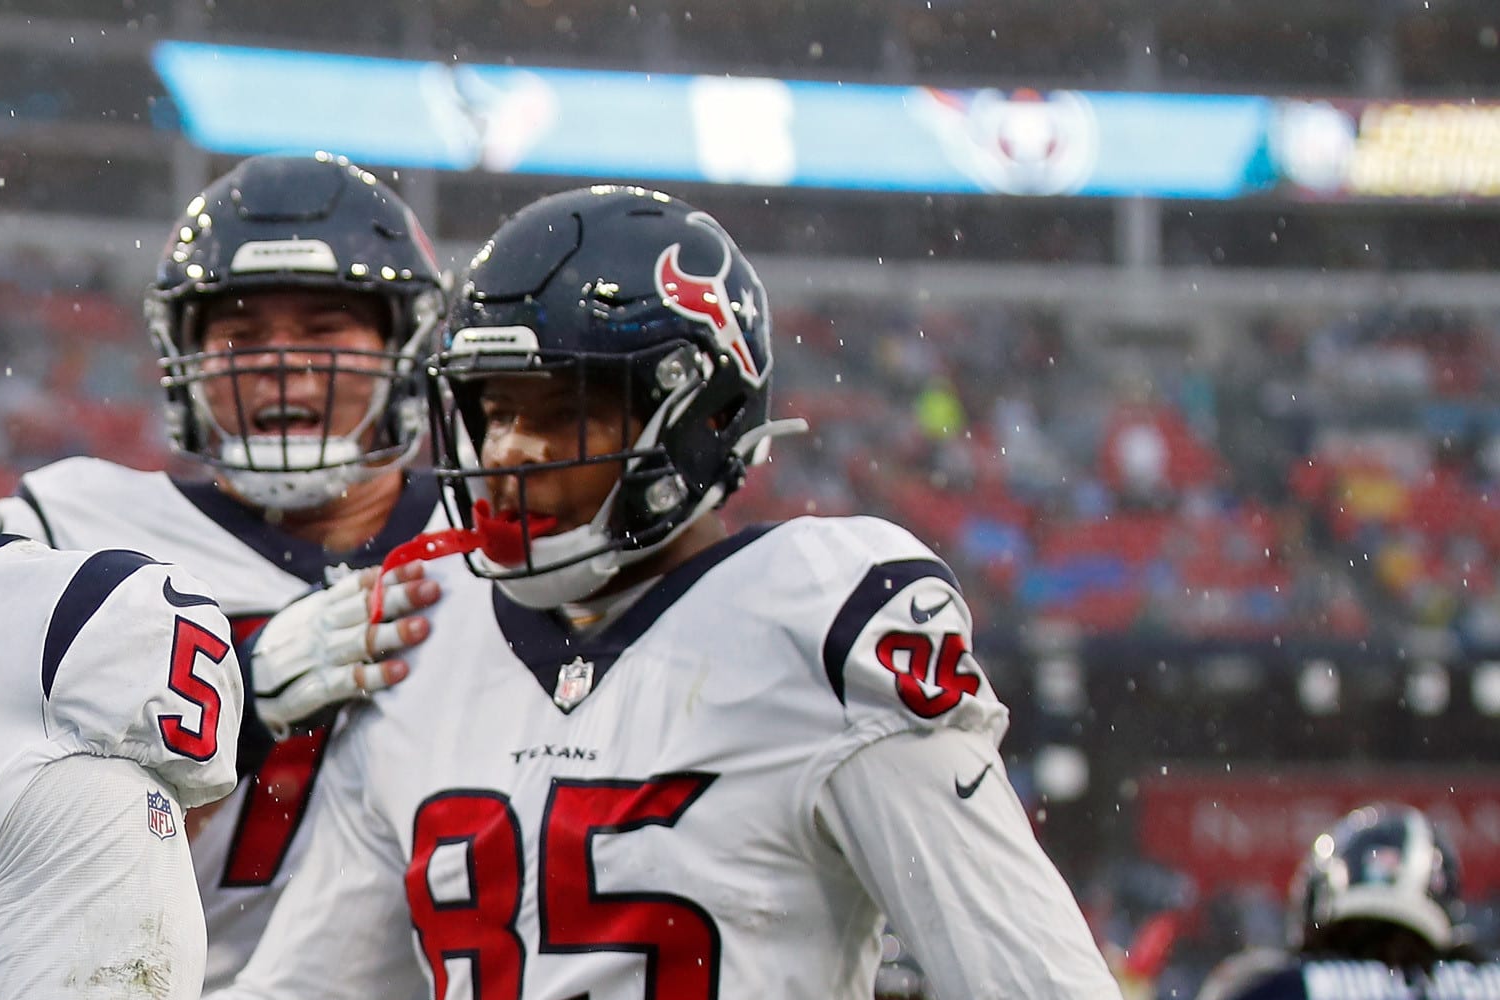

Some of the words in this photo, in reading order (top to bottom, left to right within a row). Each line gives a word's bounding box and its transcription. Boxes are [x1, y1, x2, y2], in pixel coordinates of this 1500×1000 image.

[157, 614, 230, 762] 5
[511, 743, 599, 764] TEXANS
[149, 810, 173, 834] NFL
